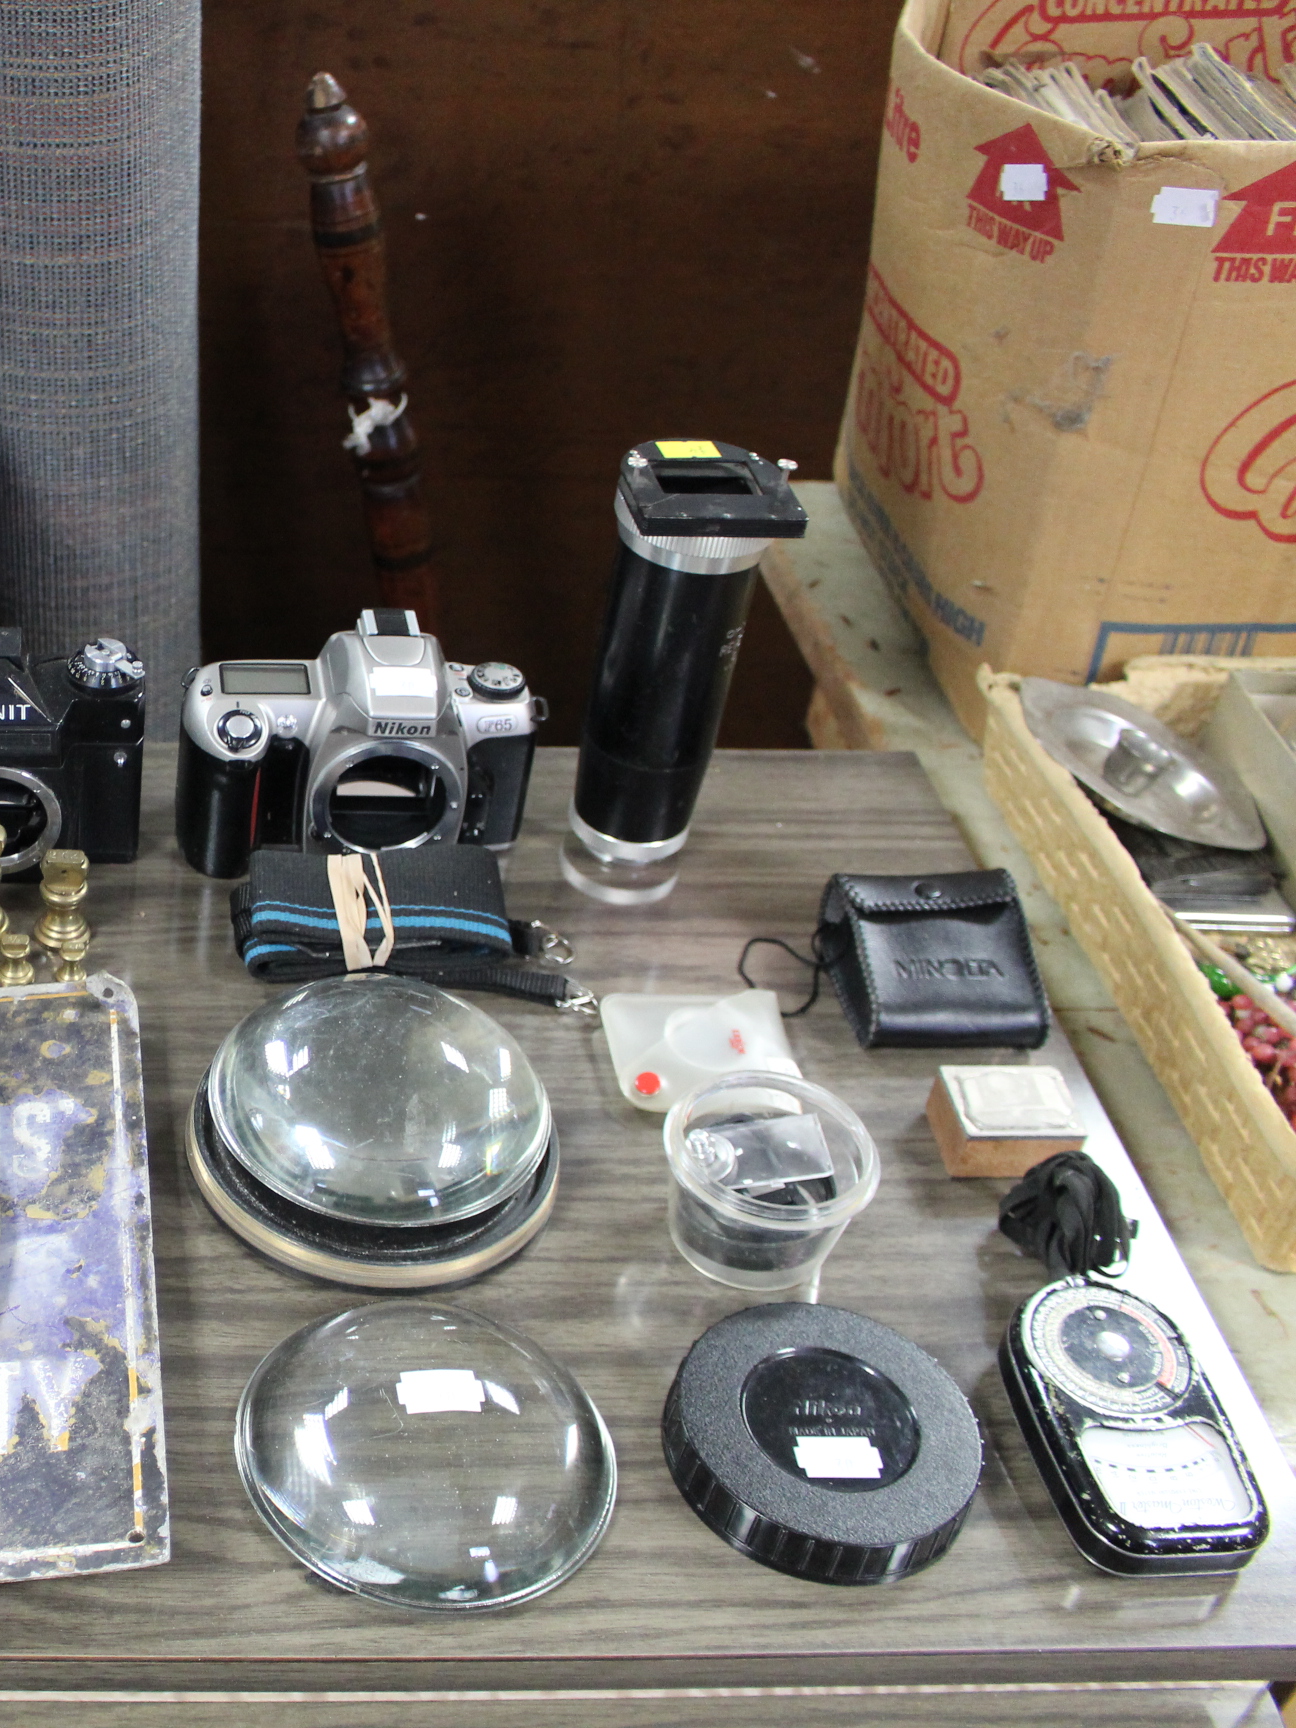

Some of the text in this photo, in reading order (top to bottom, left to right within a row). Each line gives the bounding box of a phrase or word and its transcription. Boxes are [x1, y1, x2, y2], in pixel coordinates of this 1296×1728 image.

[968, 203, 1055, 264] THIS WAY UP
[1213, 256, 1268, 283] THIS
[373, 721, 432, 736] Nikon
[483, 717, 514, 733] F65
[892, 957, 1005, 981] MINOLTA
[1131, 1499, 1183, 1514] Master
[1181, 1497, 1236, 1512] Weston
